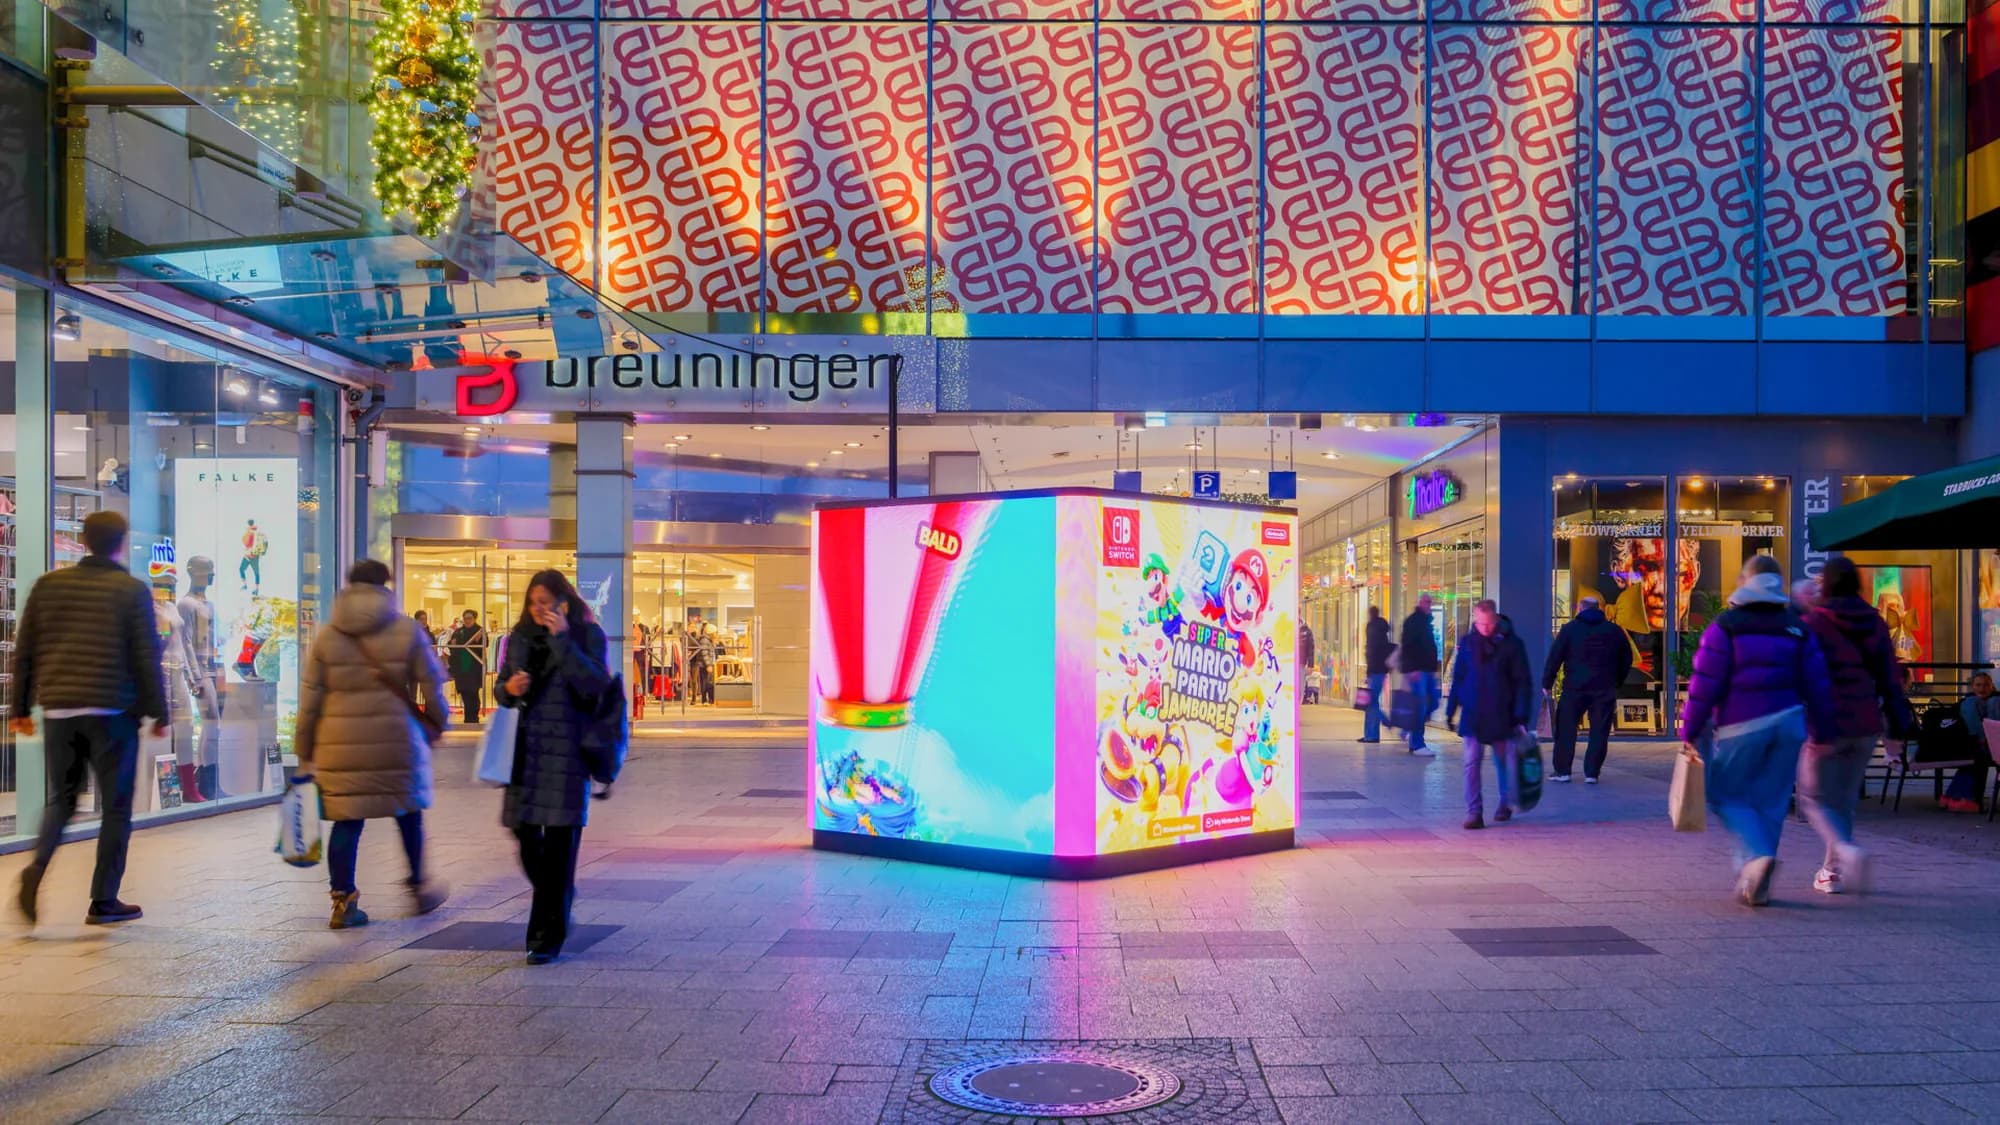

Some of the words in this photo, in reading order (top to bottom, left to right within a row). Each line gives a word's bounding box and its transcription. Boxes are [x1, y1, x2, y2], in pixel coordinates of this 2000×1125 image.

[546, 353, 891, 401] breuninger
[199, 473, 274, 482] FALKE
[1201, 477, 1212, 492] P
[1943, 476, 1988, 497] STARBUCKS
[919, 525, 959, 555] BALD
[1108, 550, 1135, 560] SWITCH
[1189, 622, 1225, 650] SUPER
[1173, 640, 1235, 679] MARIO
[1176, 670, 1226, 702] PARTY
[1159, 684, 1237, 734] JAMBOREE
